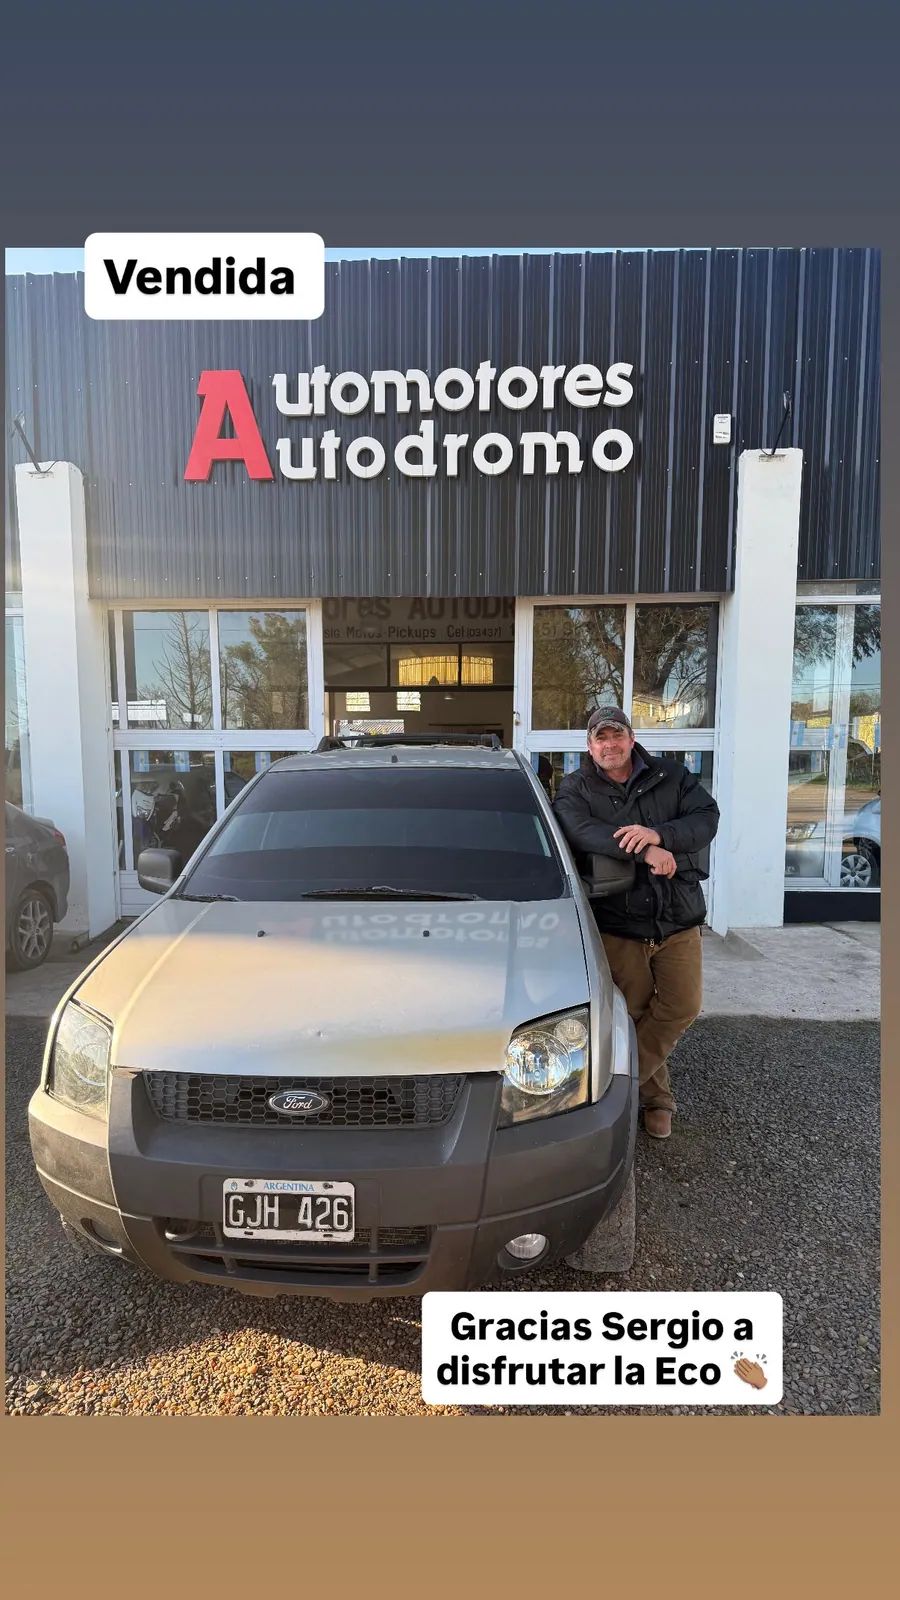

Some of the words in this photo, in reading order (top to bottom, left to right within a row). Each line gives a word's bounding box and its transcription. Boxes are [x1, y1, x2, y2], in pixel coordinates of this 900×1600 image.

[283, 1096, 313, 1109] Ford
[263, 1182, 315, 1192] ARGENTINA
[229, 1195, 279, 1228] GJH
[297, 1196, 349, 1230] 426
